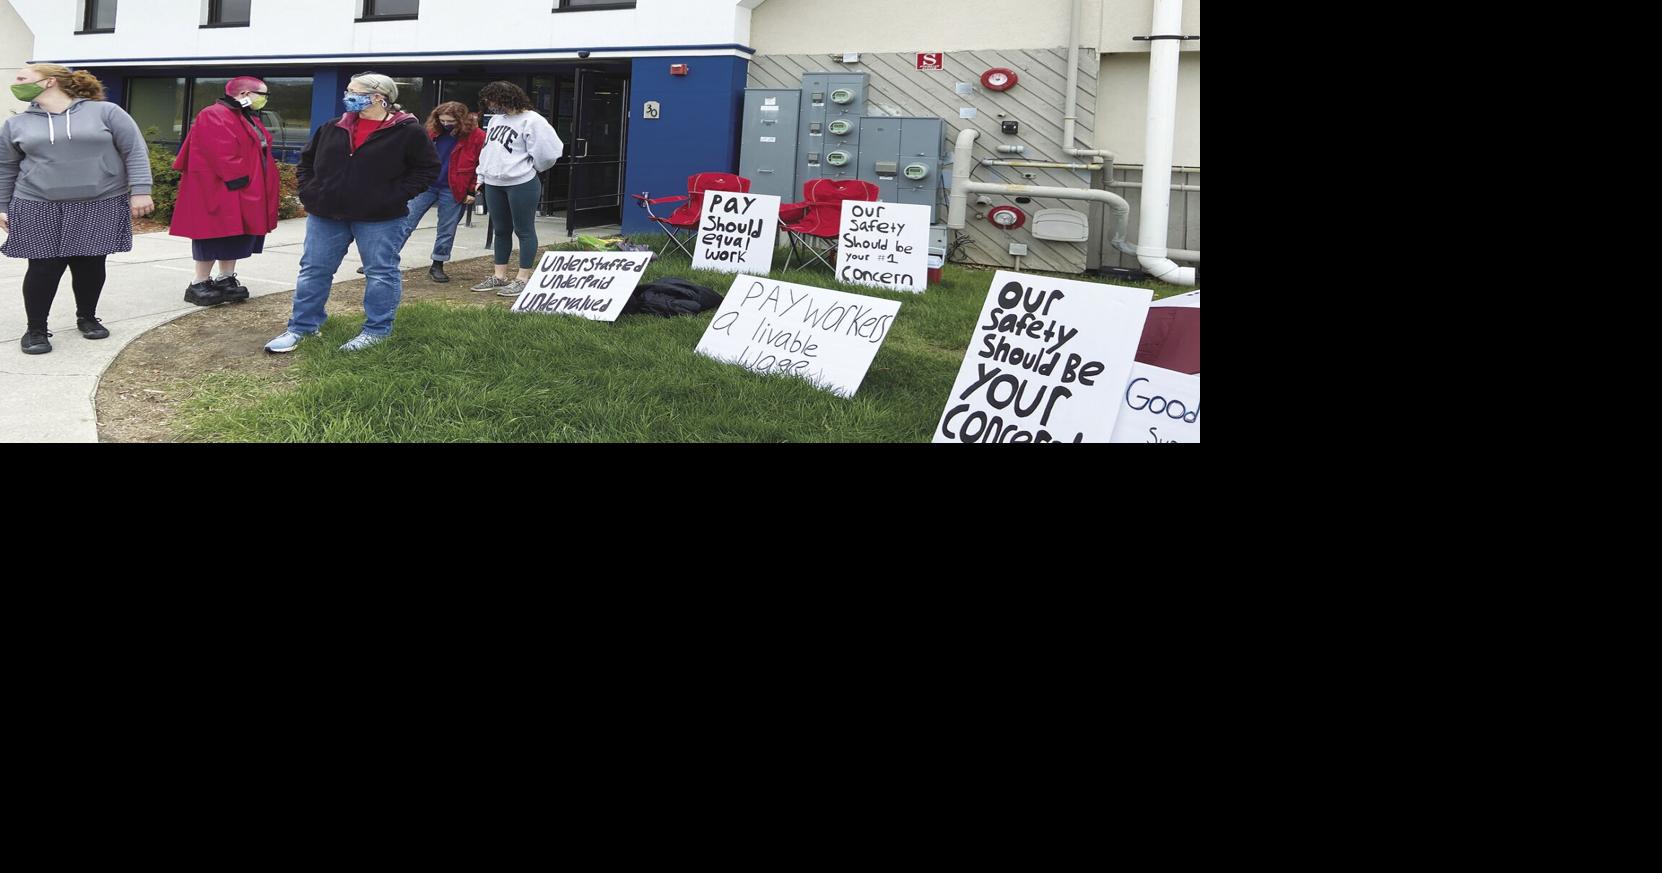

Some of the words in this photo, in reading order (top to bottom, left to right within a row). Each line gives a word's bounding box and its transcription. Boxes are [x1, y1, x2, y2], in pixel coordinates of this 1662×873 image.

[646, 104, 658, 117] 30
[702, 233, 750, 250] equal
[895, 240, 913, 254] be
[846, 252, 870, 262] your
[877, 253, 898, 264] #1
[741, 281, 808, 317] PAY
[712, 311, 739, 336] a
[752, 317, 818, 357] livable
[1061, 353, 1105, 386] Be
[1126, 377, 1200, 423] Good
